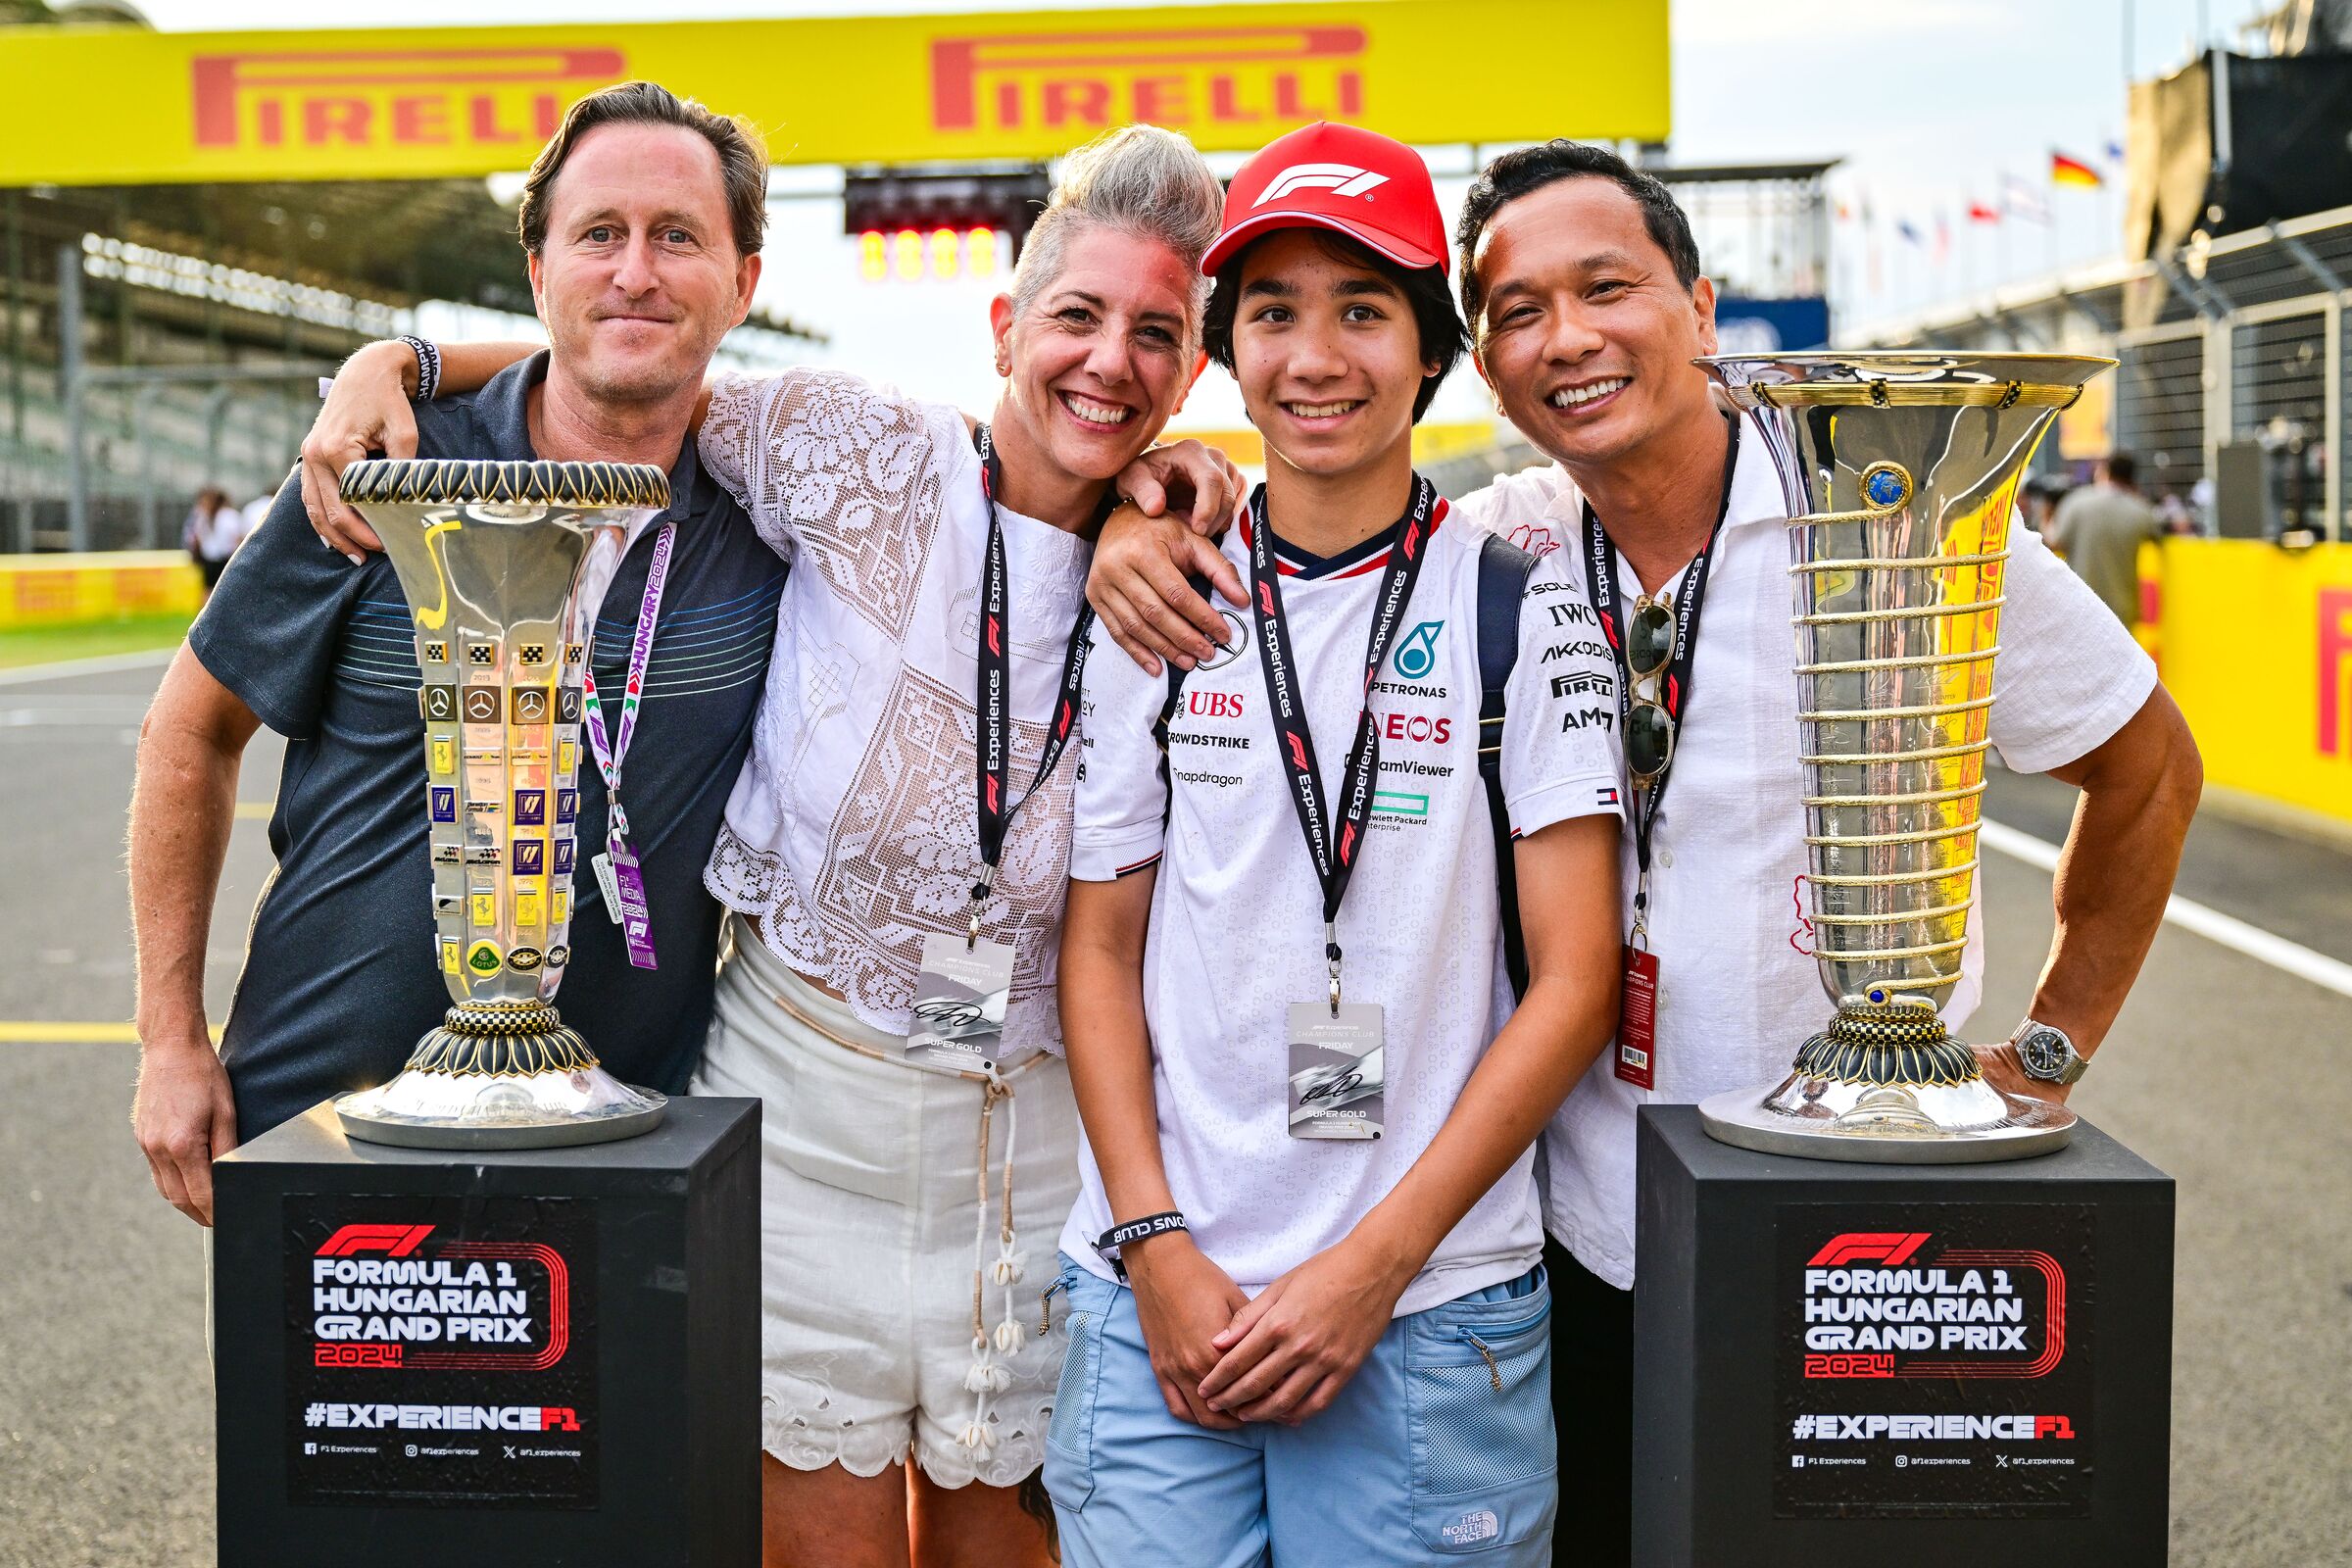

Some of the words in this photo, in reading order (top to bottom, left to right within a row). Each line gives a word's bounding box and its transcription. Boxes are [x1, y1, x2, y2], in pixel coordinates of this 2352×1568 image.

[931, 24, 1367, 130] PIRELLI
[194, 47, 626, 147] PIRELL
[1593, 517, 1610, 608] Experiences
[1370, 569, 1407, 663] Experiences
[1547, 603, 1597, 627] IWC
[1675, 558, 1703, 662] Experiences
[632, 584, 659, 669] HUNGARY
[1069, 639, 1085, 691] riences
[1265, 619, 1293, 718] Experiences
[1371, 681, 1447, 699] PETRONAS
[1550, 670, 1613, 699] PIRLLI
[1189, 691, 1244, 718] UBS
[987, 668, 1001, 771] Experiences
[1379, 760, 1454, 777] amViewer
[1298, 773, 1330, 877] Experiences
[1366, 823, 1401, 832] nterprise
[1368, 814, 1394, 823] ewlett
[1395, 816, 1428, 825] Packard
[949, 974, 982, 986] FRIDAY
[925, 1038, 956, 1049] SUPER
[956, 1043, 982, 1054] GOLD
[314, 1225, 436, 1256] F1
[1113, 1222, 1152, 1243] CLUB
[1806, 1233, 1933, 1266] F1
[313, 1259, 491, 1286] FORMULA
[496, 1261, 516, 1287] 1
[1805, 1269, 1985, 1295] FORMULA
[1992, 1269, 2012, 1295] 1
[314, 1287, 526, 1315] HUNGARIAN
[1805, 1298, 2022, 1323] HUNGARIAN
[314, 1315, 441, 1341] GRAND
[447, 1317, 532, 1343] PRIX
[1805, 1325, 1936, 1350] GRAND
[1940, 1326, 2028, 1350] PRIX
[315, 1344, 403, 1368] 2024
[1804, 1353, 1894, 1378] 2024
[304, 1402, 581, 1432] #EXPERIENCEF1
[1792, 1414, 2075, 1440] #EXPERIENCEF1
[331, 1446, 377, 1454] Experiences
[1819, 1457, 1867, 1466] Experiences
[1443, 1521, 1482, 1537] NORTH
[1462, 1512, 1483, 1525] THE
[1454, 1530, 1483, 1544] FACE
